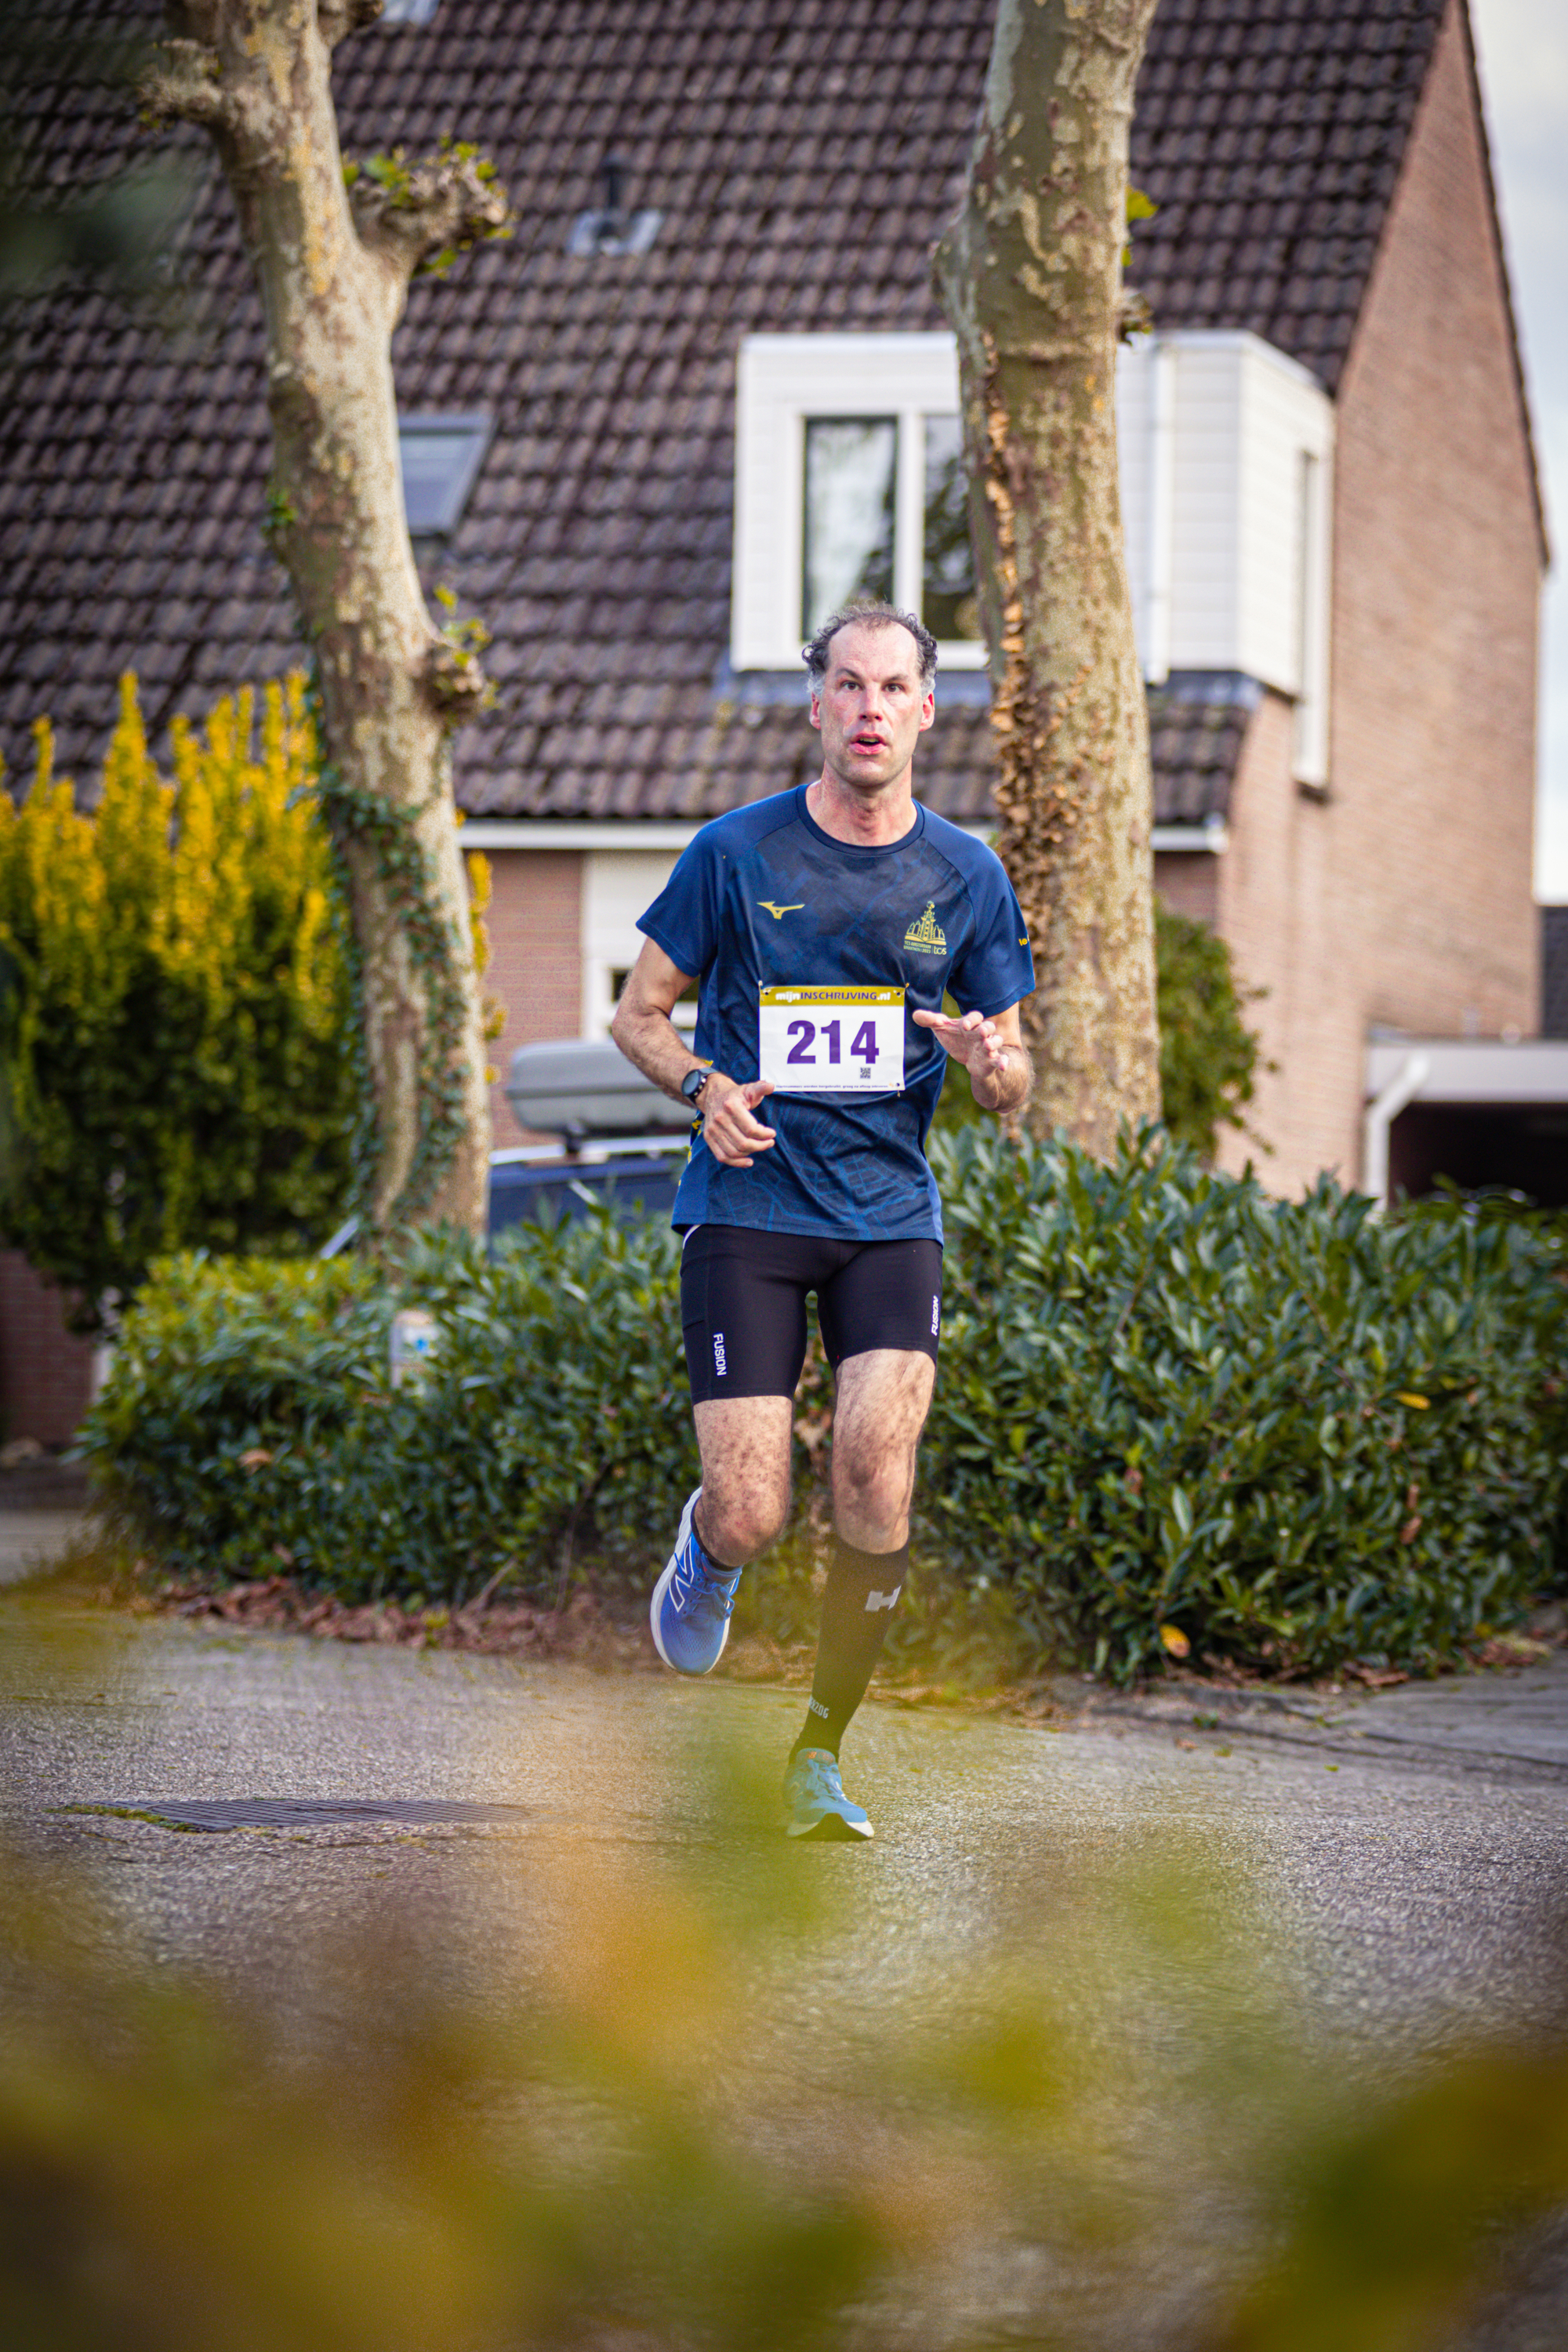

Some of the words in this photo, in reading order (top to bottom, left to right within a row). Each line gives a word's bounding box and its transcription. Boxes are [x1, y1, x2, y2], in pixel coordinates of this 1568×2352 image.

[933, 945, 947, 956] tcs
[775, 991, 891, 1004] mijnINSCHRIJVING.nl
[786, 1019, 880, 1065] 214
[931, 1294, 939, 1337] FUSION
[713, 1333, 727, 1377] FUSION
